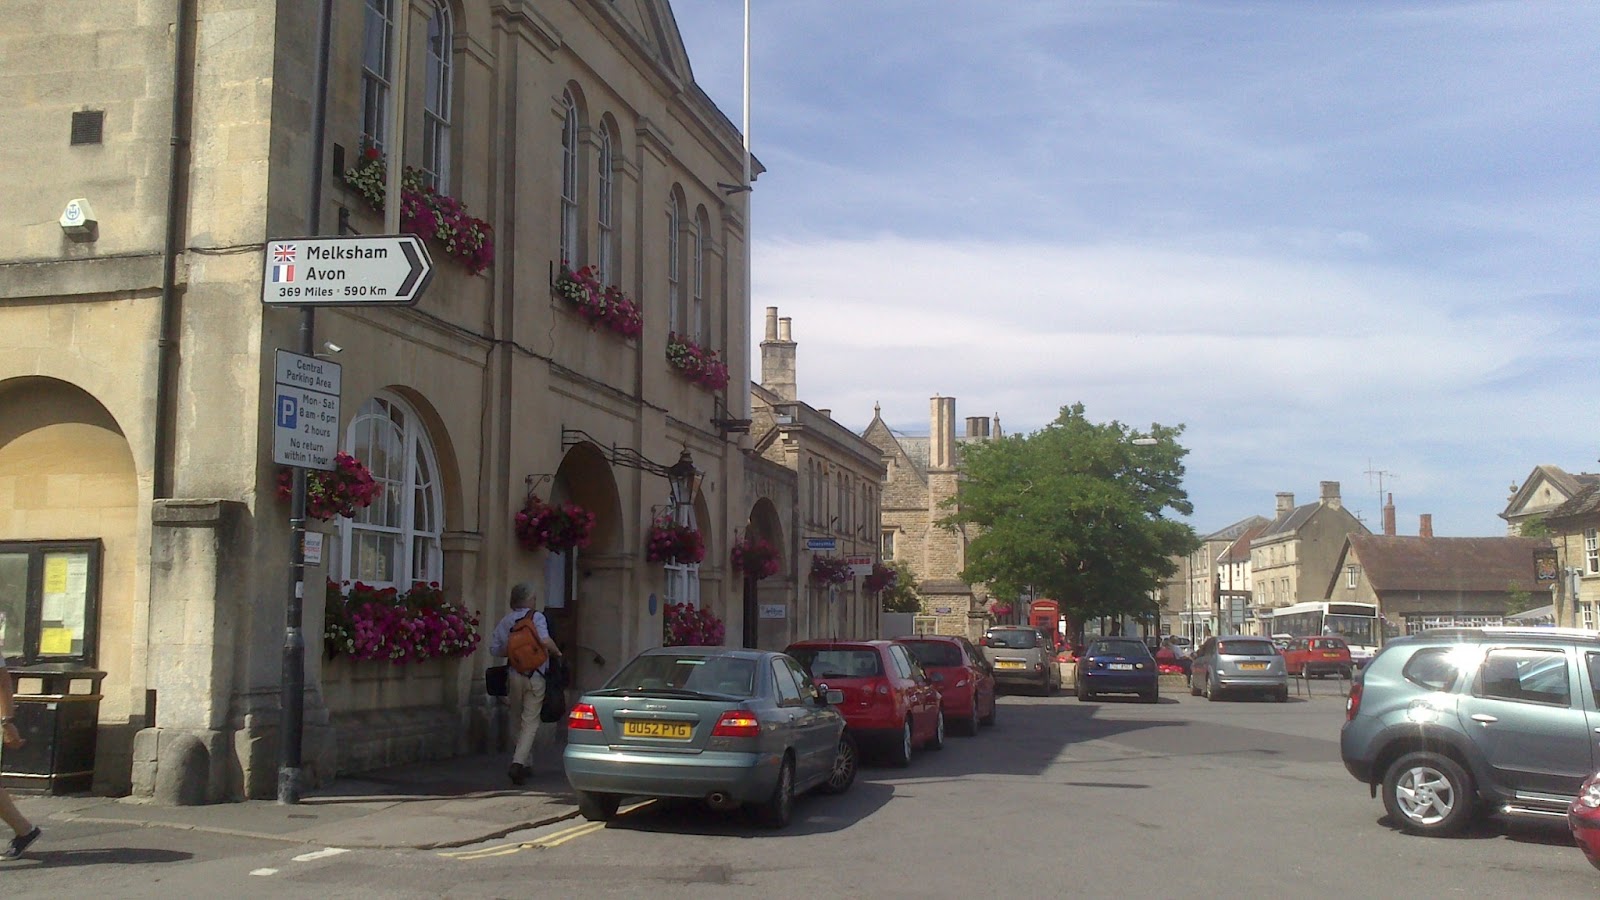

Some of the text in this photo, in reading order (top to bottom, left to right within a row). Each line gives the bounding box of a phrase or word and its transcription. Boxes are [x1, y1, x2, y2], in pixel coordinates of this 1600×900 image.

[306, 246, 388, 260] Melksham
[305, 267, 346, 281] Avon
[279, 287, 301, 297] 369
[304, 287, 333, 297] Miles
[344, 286, 367, 296] 590
[369, 286, 387, 296] Km
[297, 359, 323, 374] Central
[286, 369, 332, 389] Parking Area
[302, 394, 318, 406] Mon
[322, 398, 335, 410] Sat
[282, 399, 295, 425] P
[304, 423, 331, 438] 2 hours
[290, 437, 324, 453] No return
[284, 451, 306, 462] within
[312, 454, 329, 465] hour
[662, 722, 687, 736] PYG
